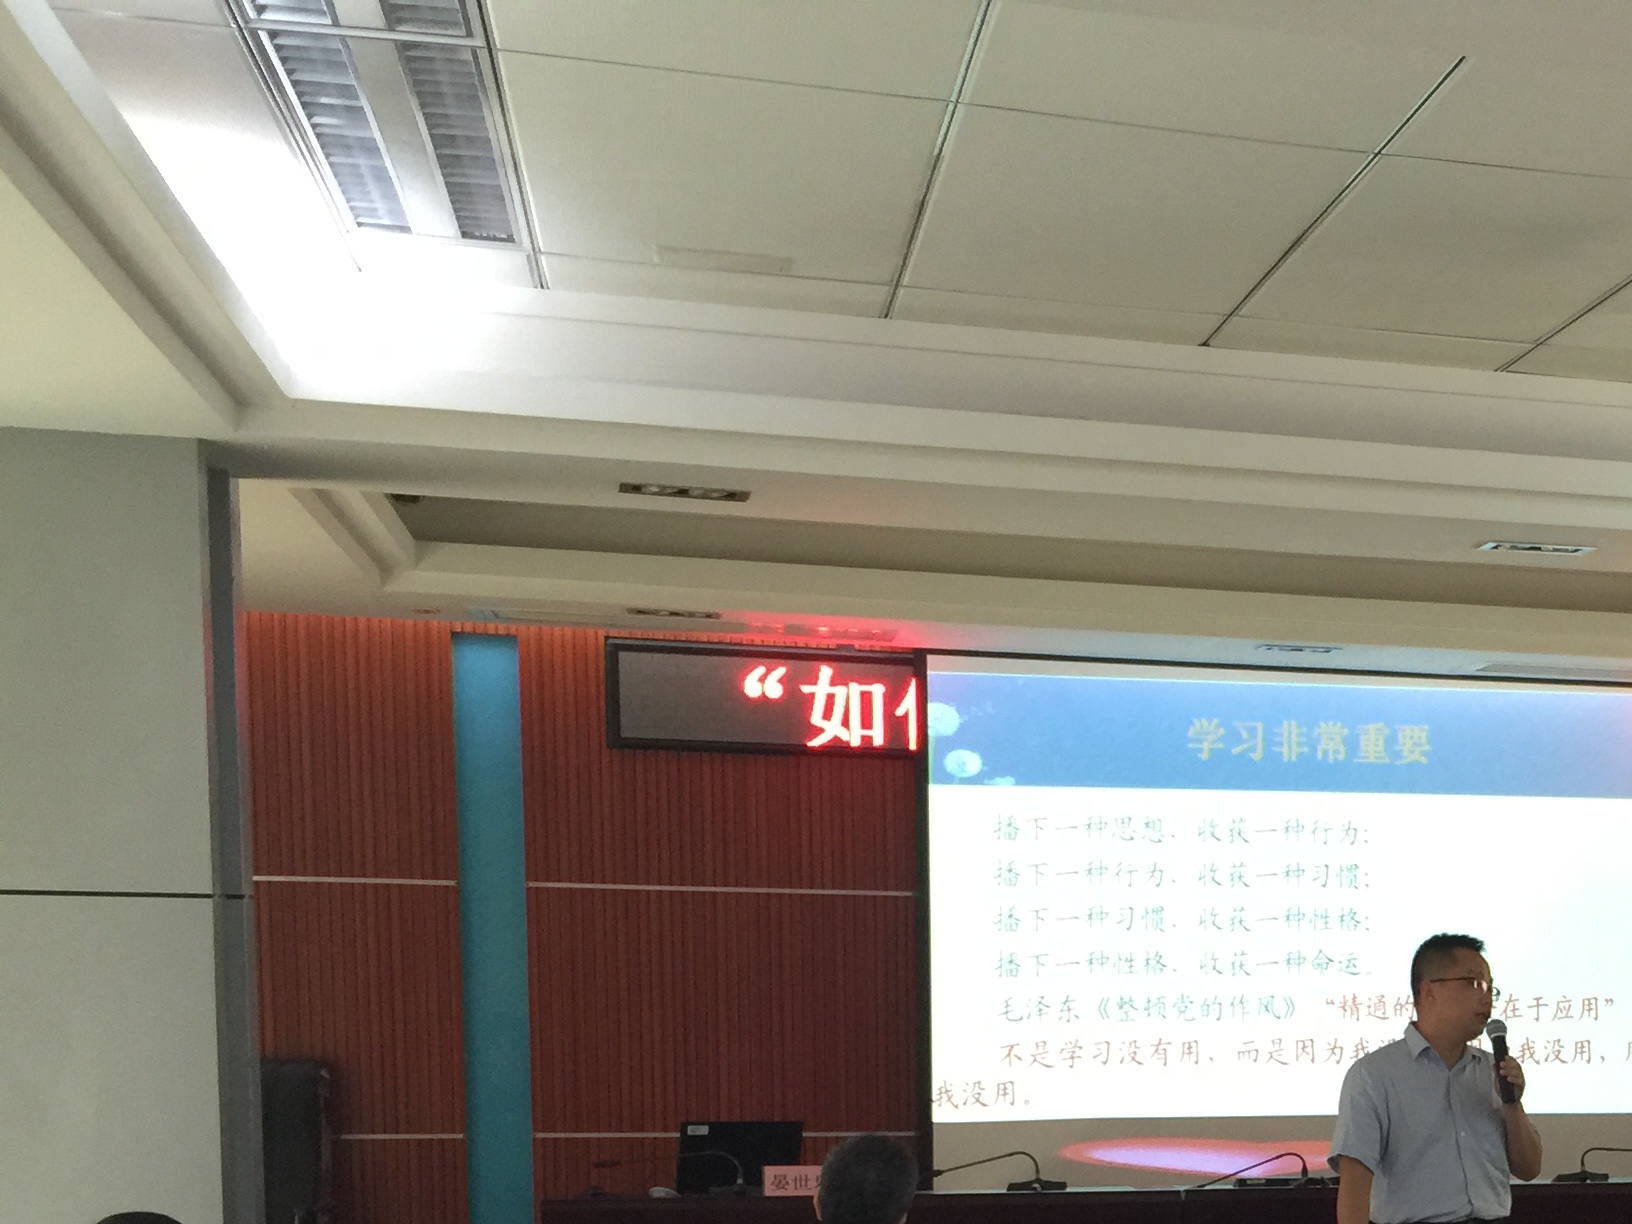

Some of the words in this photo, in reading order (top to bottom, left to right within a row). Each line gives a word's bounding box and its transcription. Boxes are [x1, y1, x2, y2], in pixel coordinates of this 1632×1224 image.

[1187, 717, 1432, 765] 学习非常重要
[770, 1173, 821, 1192] 晏世
